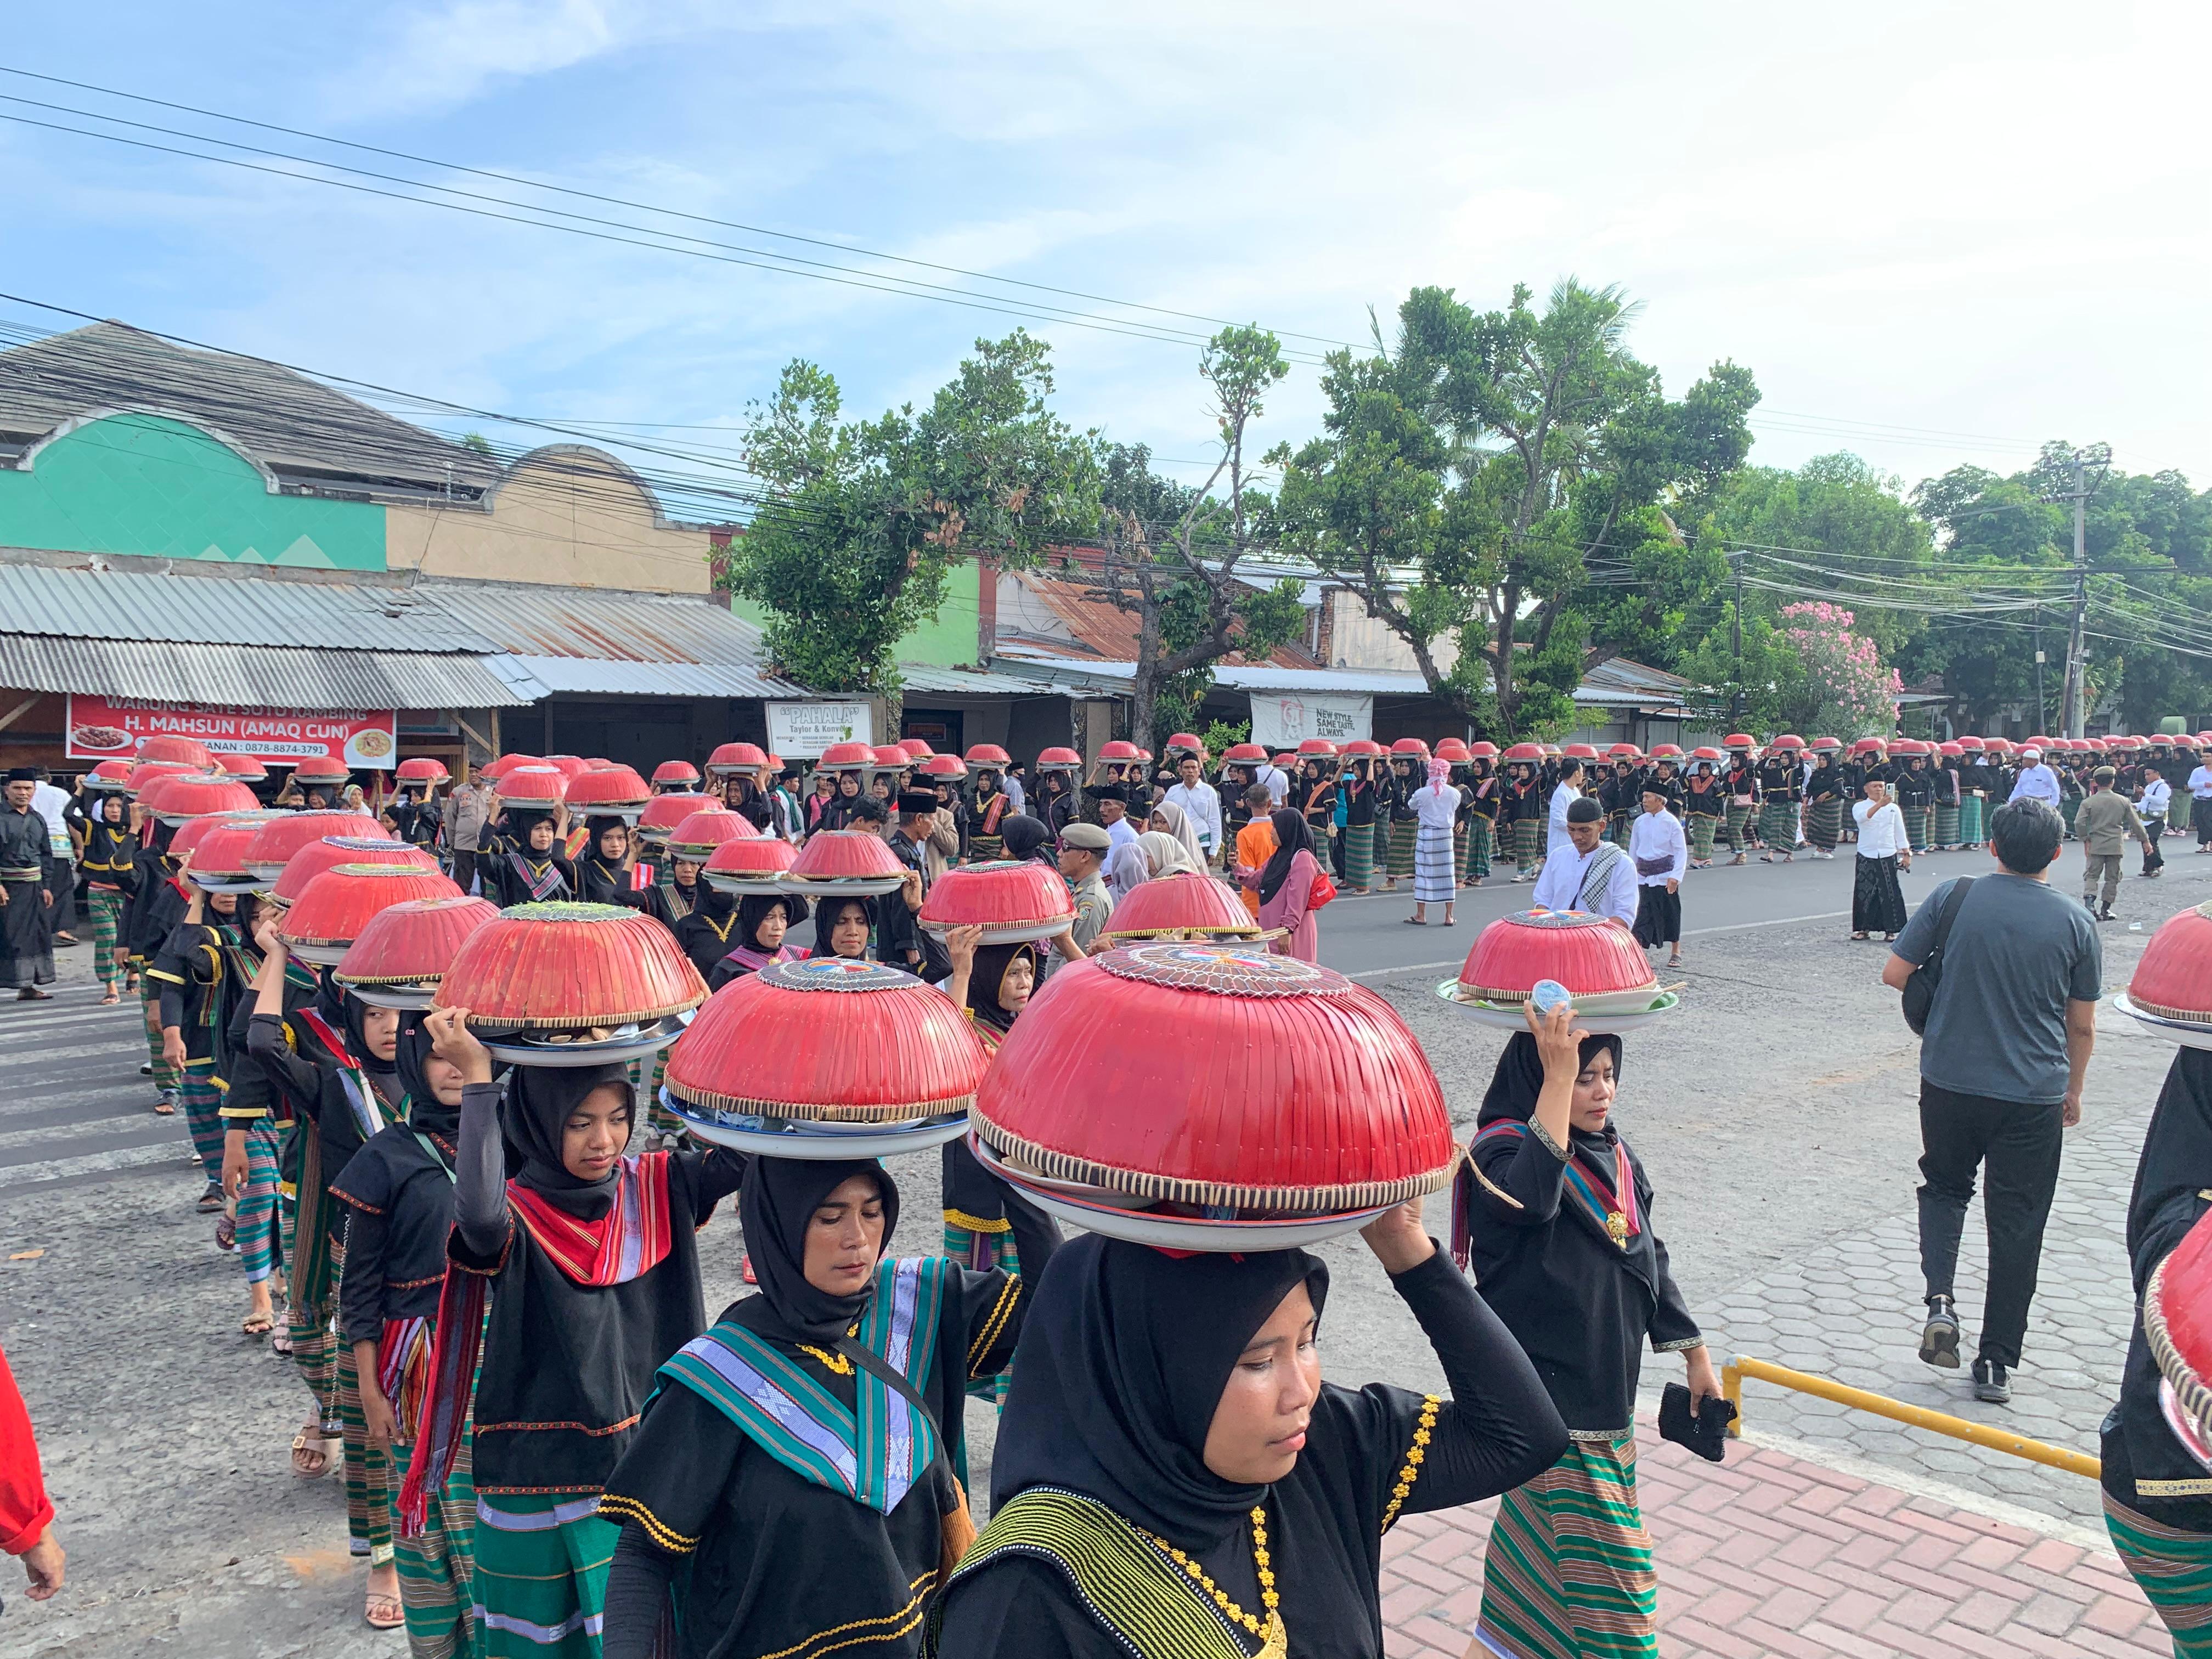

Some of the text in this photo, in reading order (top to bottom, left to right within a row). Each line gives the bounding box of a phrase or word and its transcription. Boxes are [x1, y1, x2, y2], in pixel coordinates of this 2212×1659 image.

[105, 695, 189, 712] WARUNG
[1317, 708, 1333, 719] NEW
[125, 715, 349, 742] H. MAHSUN (AMAQ CUN)
[789, 725, 811, 734] Taylor
[1317, 718, 1355, 731] SAME TASTE,
[1317, 727, 1345, 737] ALWAYS.
[246, 743, 324, 754] 0878-8874-3791
